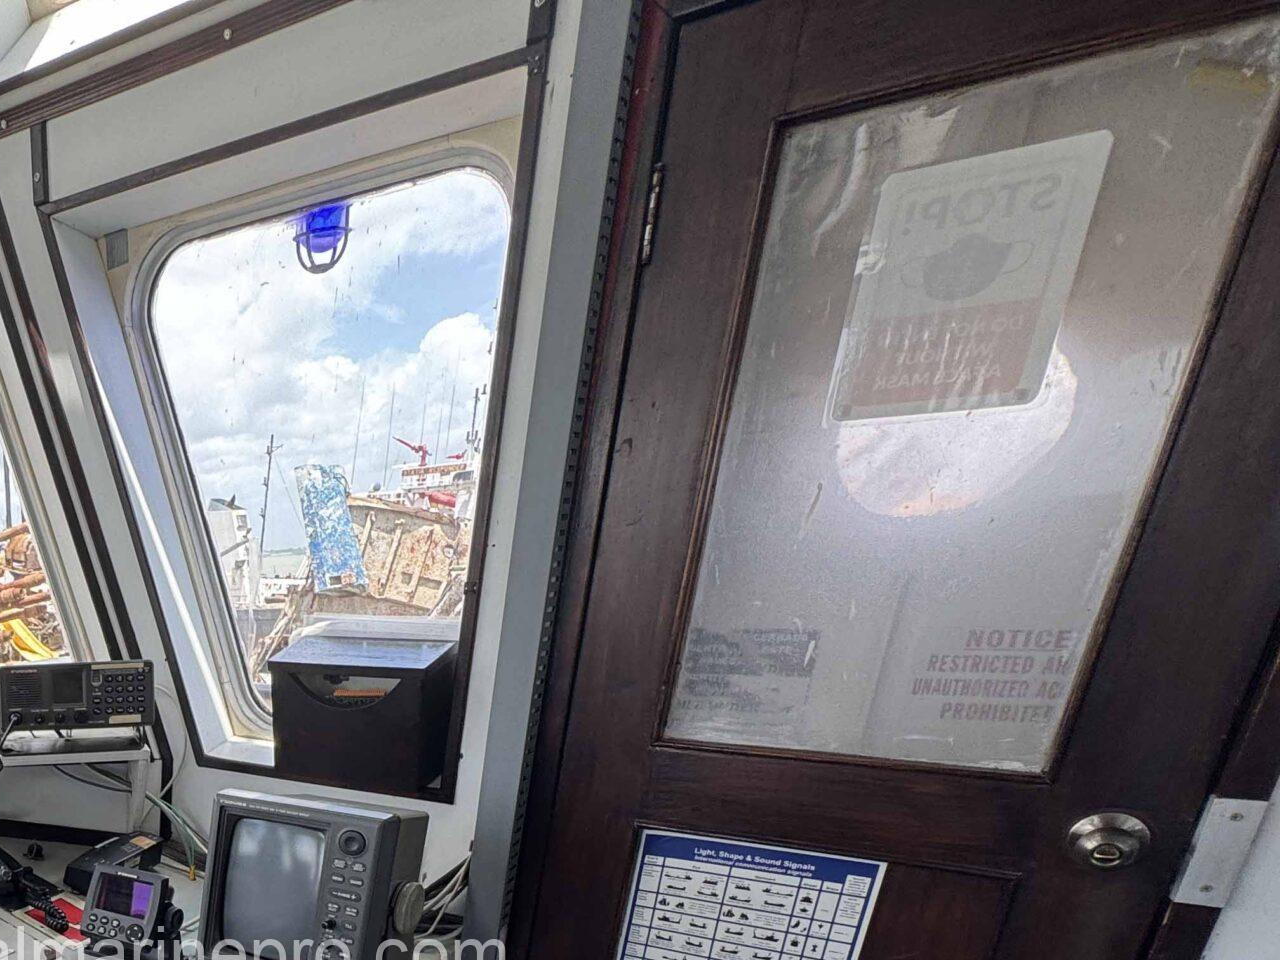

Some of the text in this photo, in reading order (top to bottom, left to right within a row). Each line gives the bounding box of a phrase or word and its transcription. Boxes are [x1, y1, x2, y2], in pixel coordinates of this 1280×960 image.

[965, 629, 1071, 649] NOTICE
[926, 654, 1034, 674] RESTRICTED
[911, 678, 1030, 698] UNAUTHORIZED
[694, 847, 816, 871] Light, Shape & Sound Signals
